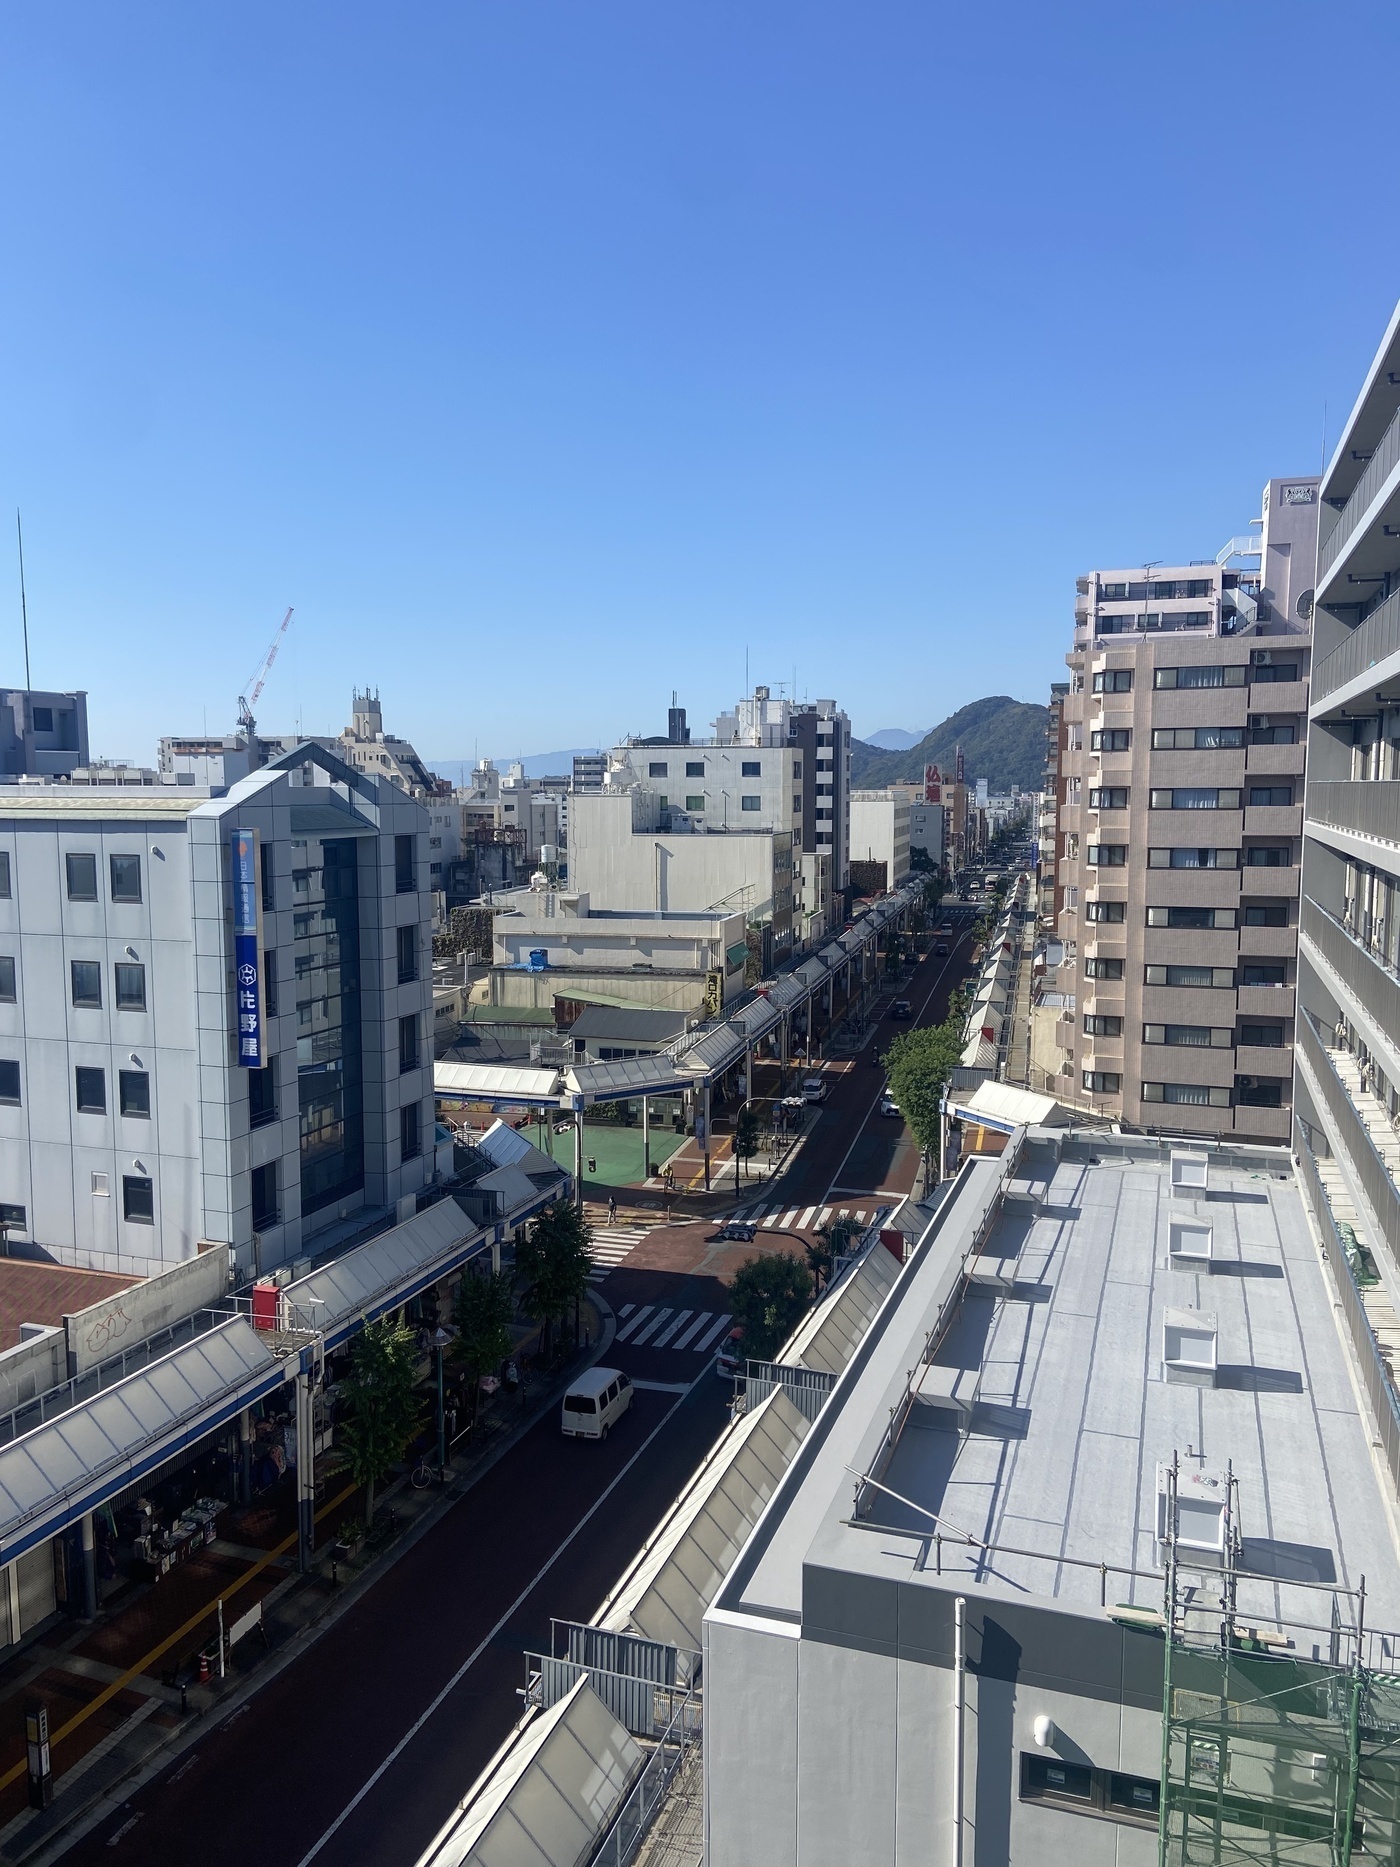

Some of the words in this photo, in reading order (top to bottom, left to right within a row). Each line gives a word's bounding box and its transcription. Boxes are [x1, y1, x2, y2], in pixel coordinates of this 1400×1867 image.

[926, 765, 941, 802] 仏壇
[240, 990, 258, 1057] 片野屋
